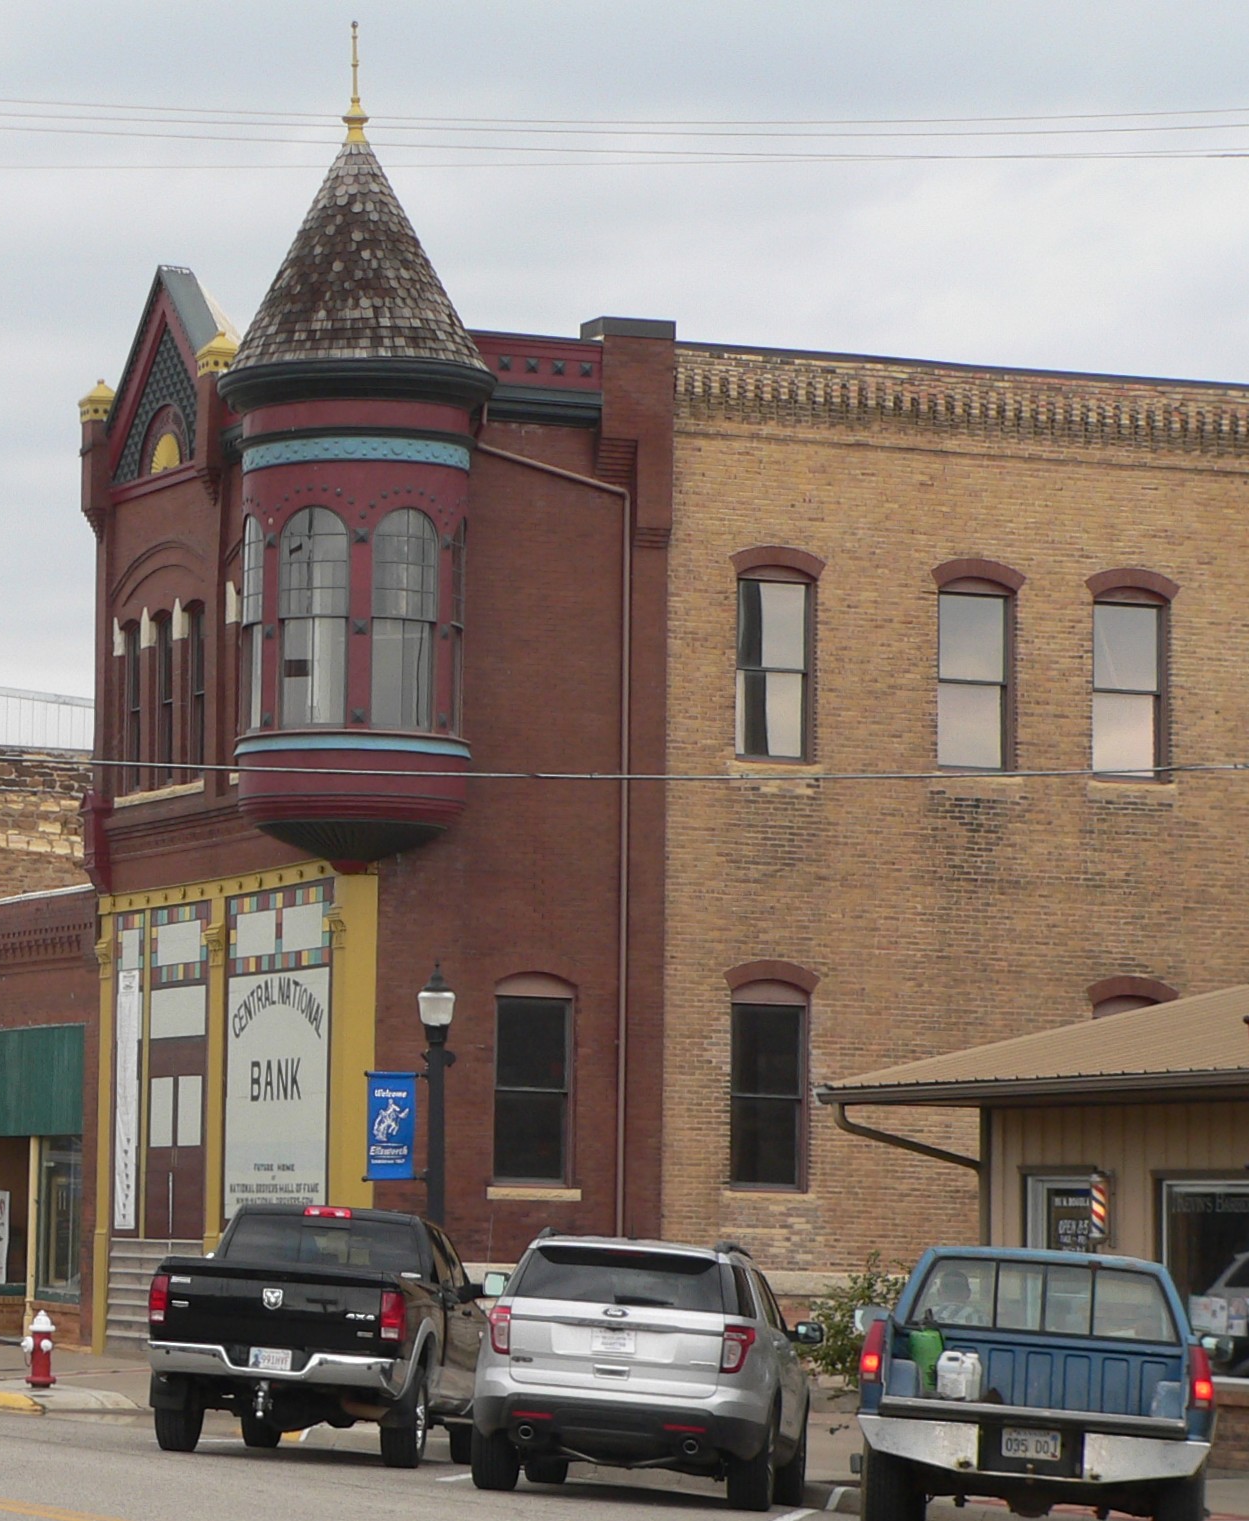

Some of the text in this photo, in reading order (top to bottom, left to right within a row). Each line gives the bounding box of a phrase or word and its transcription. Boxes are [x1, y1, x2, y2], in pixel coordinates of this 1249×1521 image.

[232, 976, 324, 1039] CENTRAL NATIONAL
[250, 1057, 301, 1102] BANK
[374, 1088, 407, 1098] Welcome
[369, 1145, 408, 1156] Ellsworth
[253, 1163, 295, 1172] FUTURE HOME
[229, 1183, 255, 1194] NATIONAL
[279, 1183, 294, 1193] HALL
[302, 1182, 320, 1193] FAME
[1058, 1219, 1076, 1234] OPEN
[1005, 1437, 1029, 1454] 035
